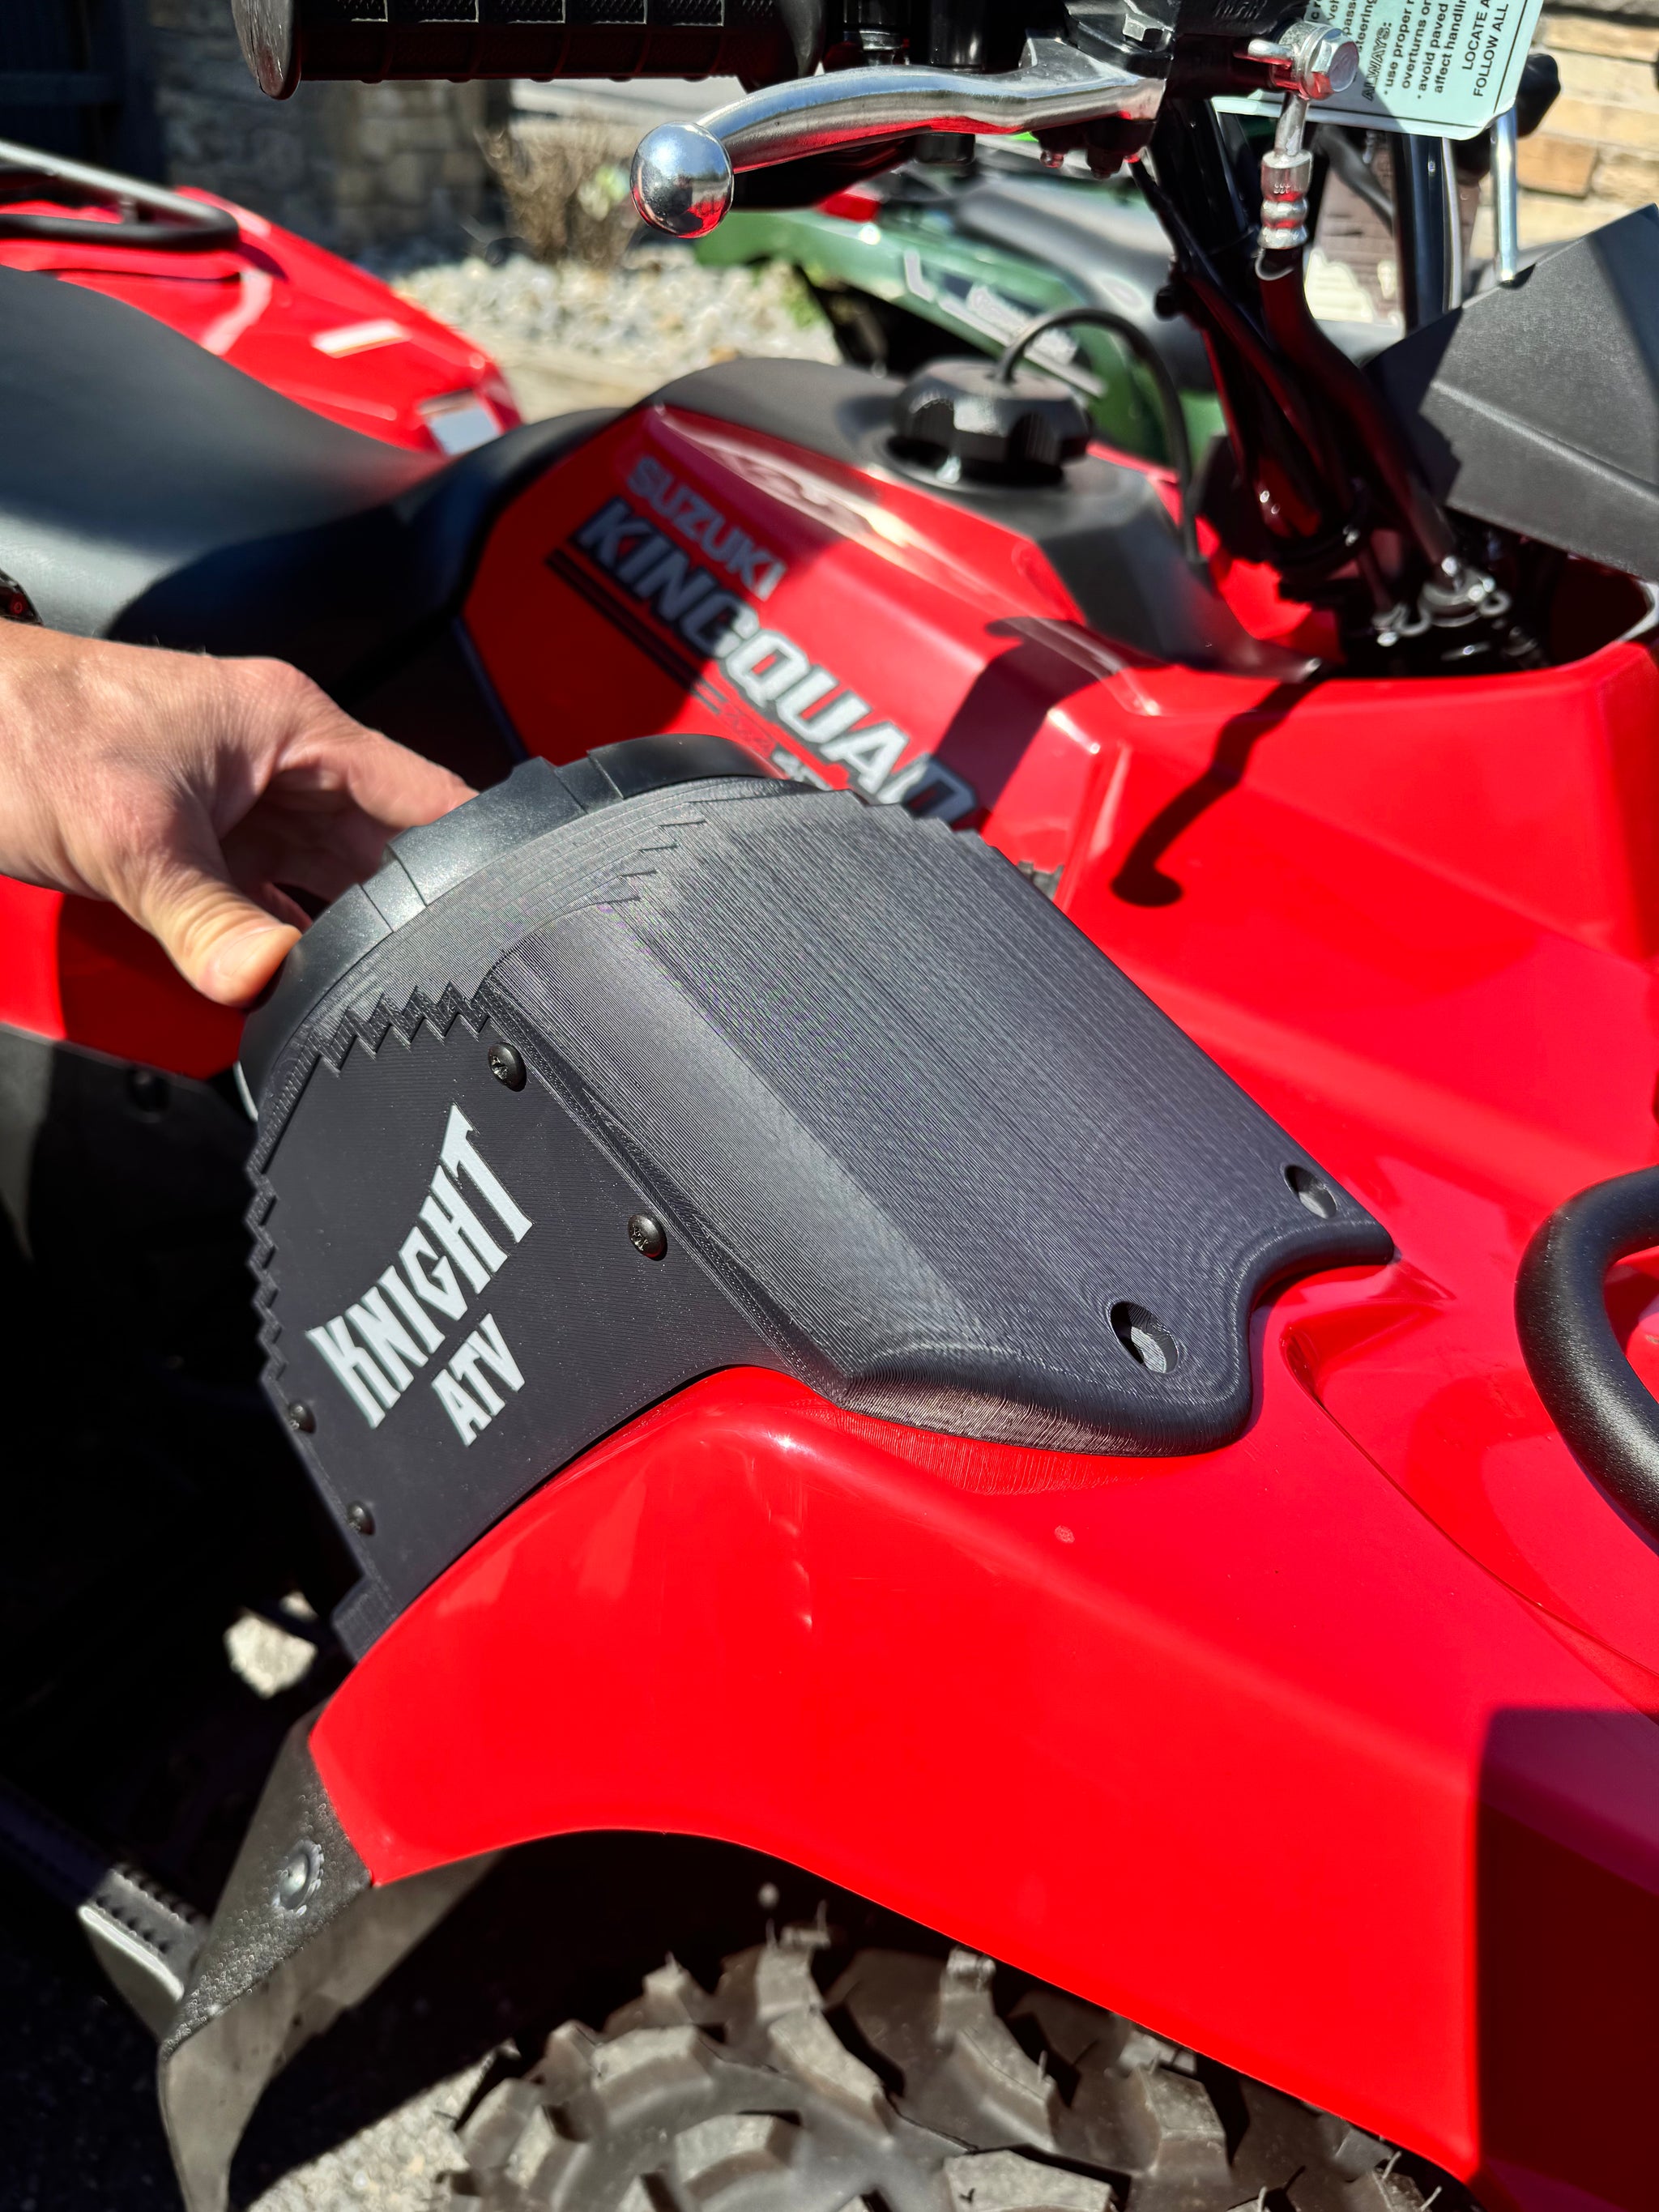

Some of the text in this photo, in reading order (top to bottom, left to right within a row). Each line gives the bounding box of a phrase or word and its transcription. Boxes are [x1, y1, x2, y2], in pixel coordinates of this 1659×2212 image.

[1342, 0, 1358, 35] pass
[1385, 62, 1398, 87] use
[1393, 8, 1412, 58] proper
[1401, 19, 1427, 88] overturns
[1418, 3, 1448, 92] avoid paved
[1462, 11, 1488, 70] LOCATE
[1473, 3, 1509, 97] FOLLOW ALL
[1362, 22, 1392, 101] ALWAYS:
[1435, 53, 1452, 93] affect
[629, 456, 787, 601] SUZUKI
[569, 494, 979, 825] KINGQUAD
[305, 1103, 533, 1430] KNIGHT
[431, 1313, 525, 1448] ATV
